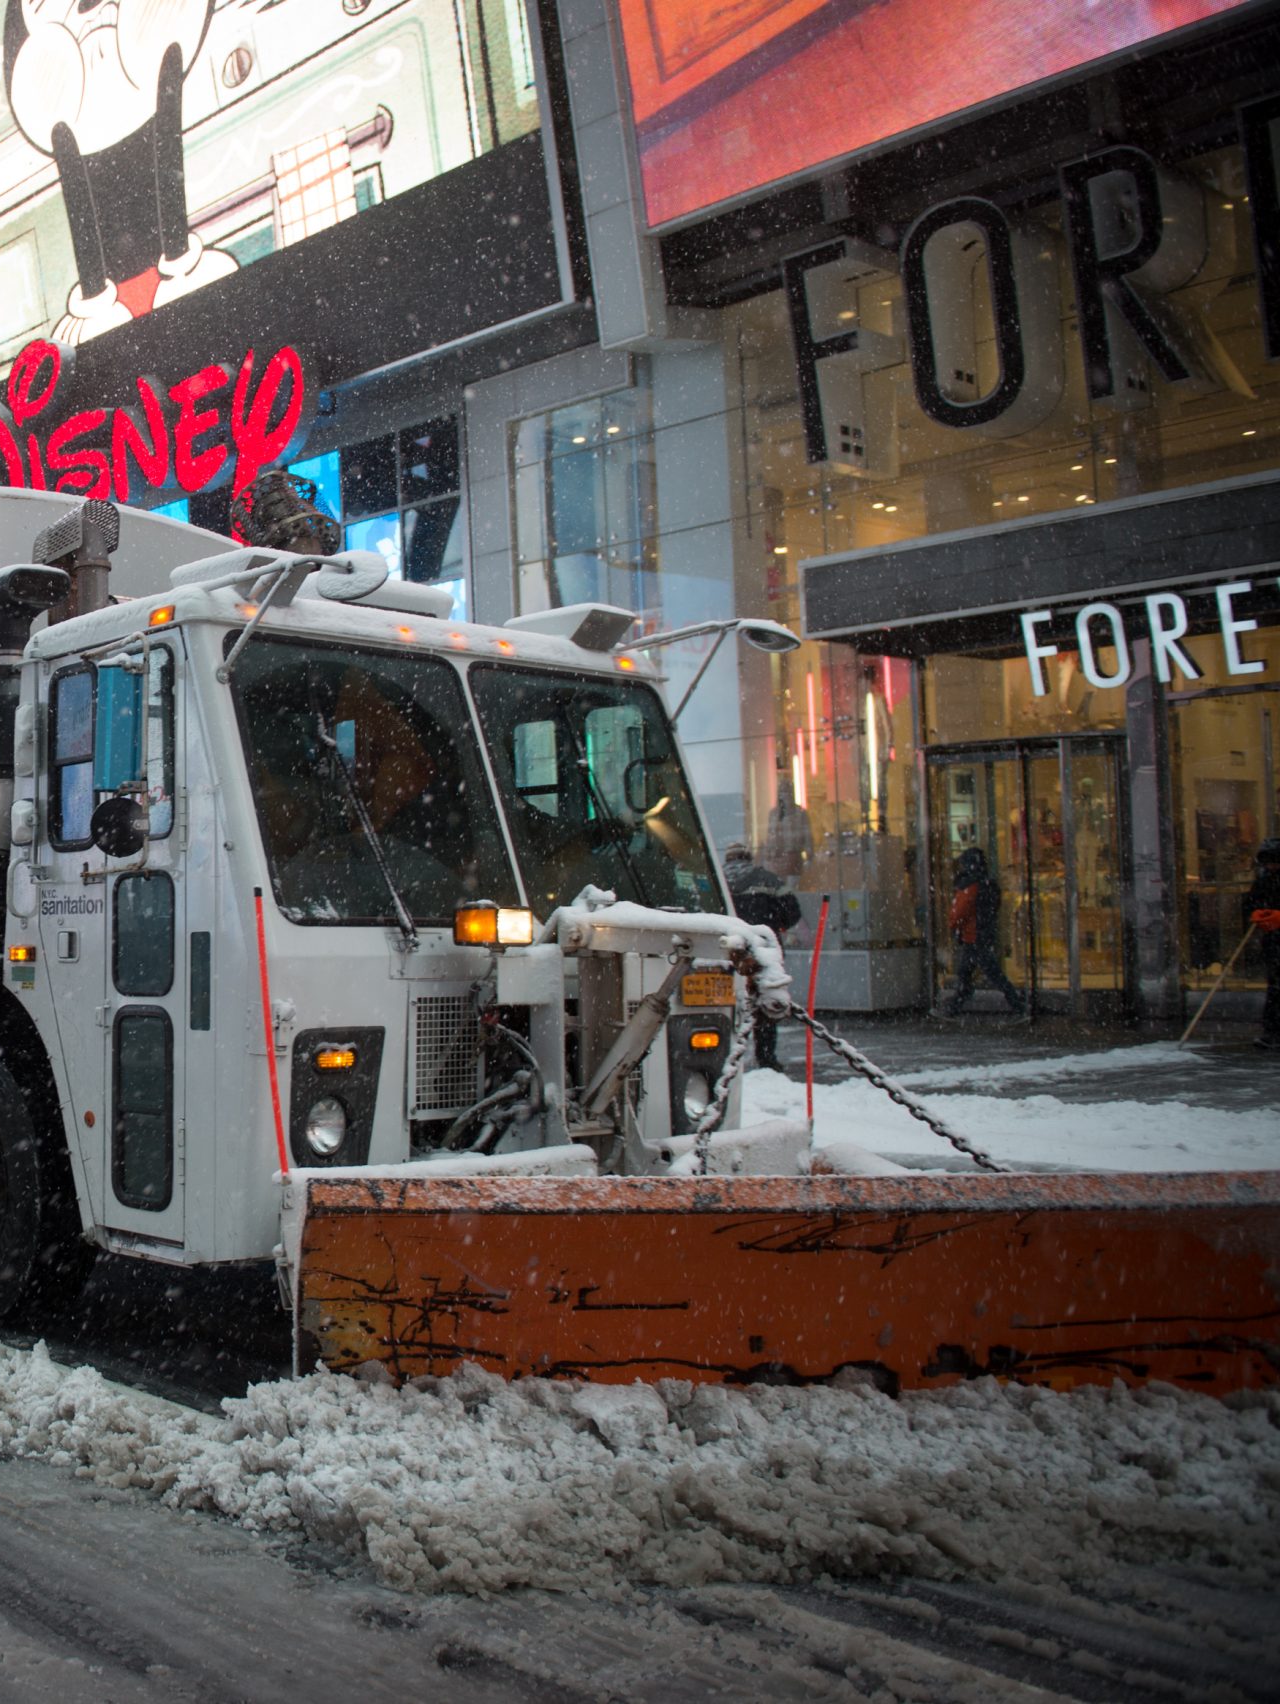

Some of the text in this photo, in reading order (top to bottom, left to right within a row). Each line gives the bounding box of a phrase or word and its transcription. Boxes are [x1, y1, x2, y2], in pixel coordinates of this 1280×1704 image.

[781, 95, 1280, 465] FOR
[1020, 575, 1280, 698] FORE
[41, 896, 104, 916] sanitation
